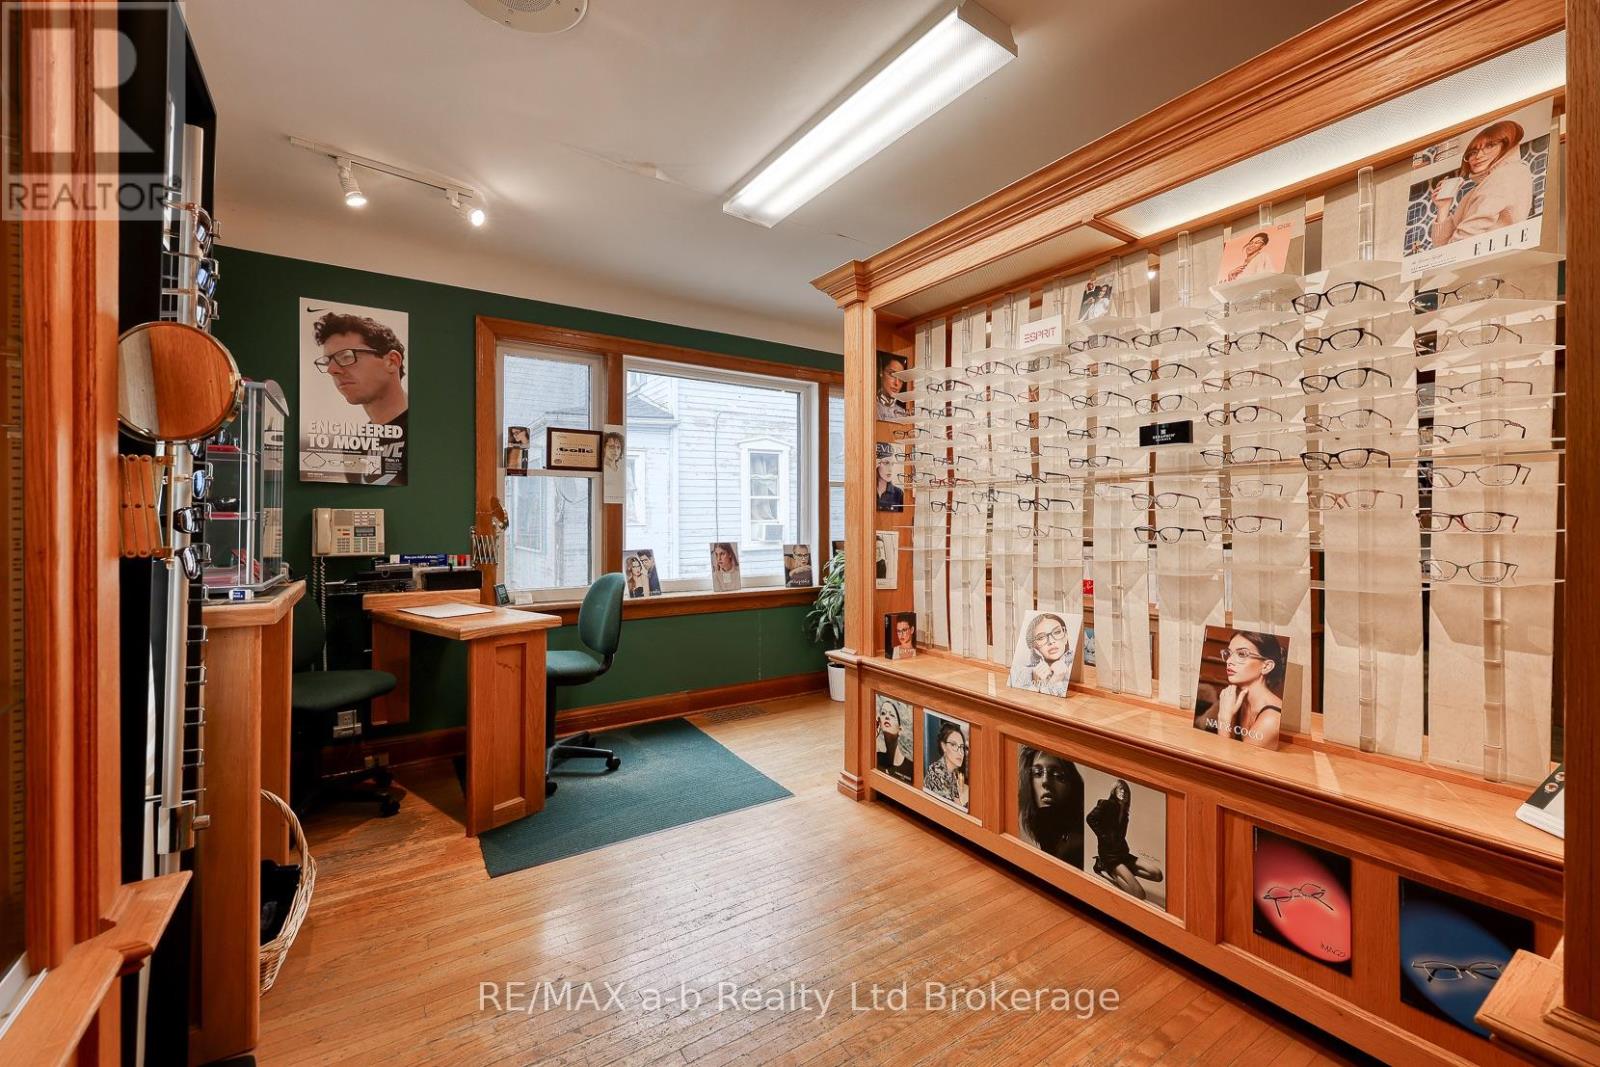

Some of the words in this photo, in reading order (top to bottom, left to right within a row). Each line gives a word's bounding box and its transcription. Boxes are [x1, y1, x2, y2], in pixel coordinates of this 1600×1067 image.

[1474, 228, 1529, 256] ELLE
[1024, 326, 1057, 344] ESPRIT
[308, 418, 404, 439] ENGINEERED
[306, 433, 330, 448] TO
[332, 435, 385, 451] MOVE.
[1225, 720, 1232, 732] &
